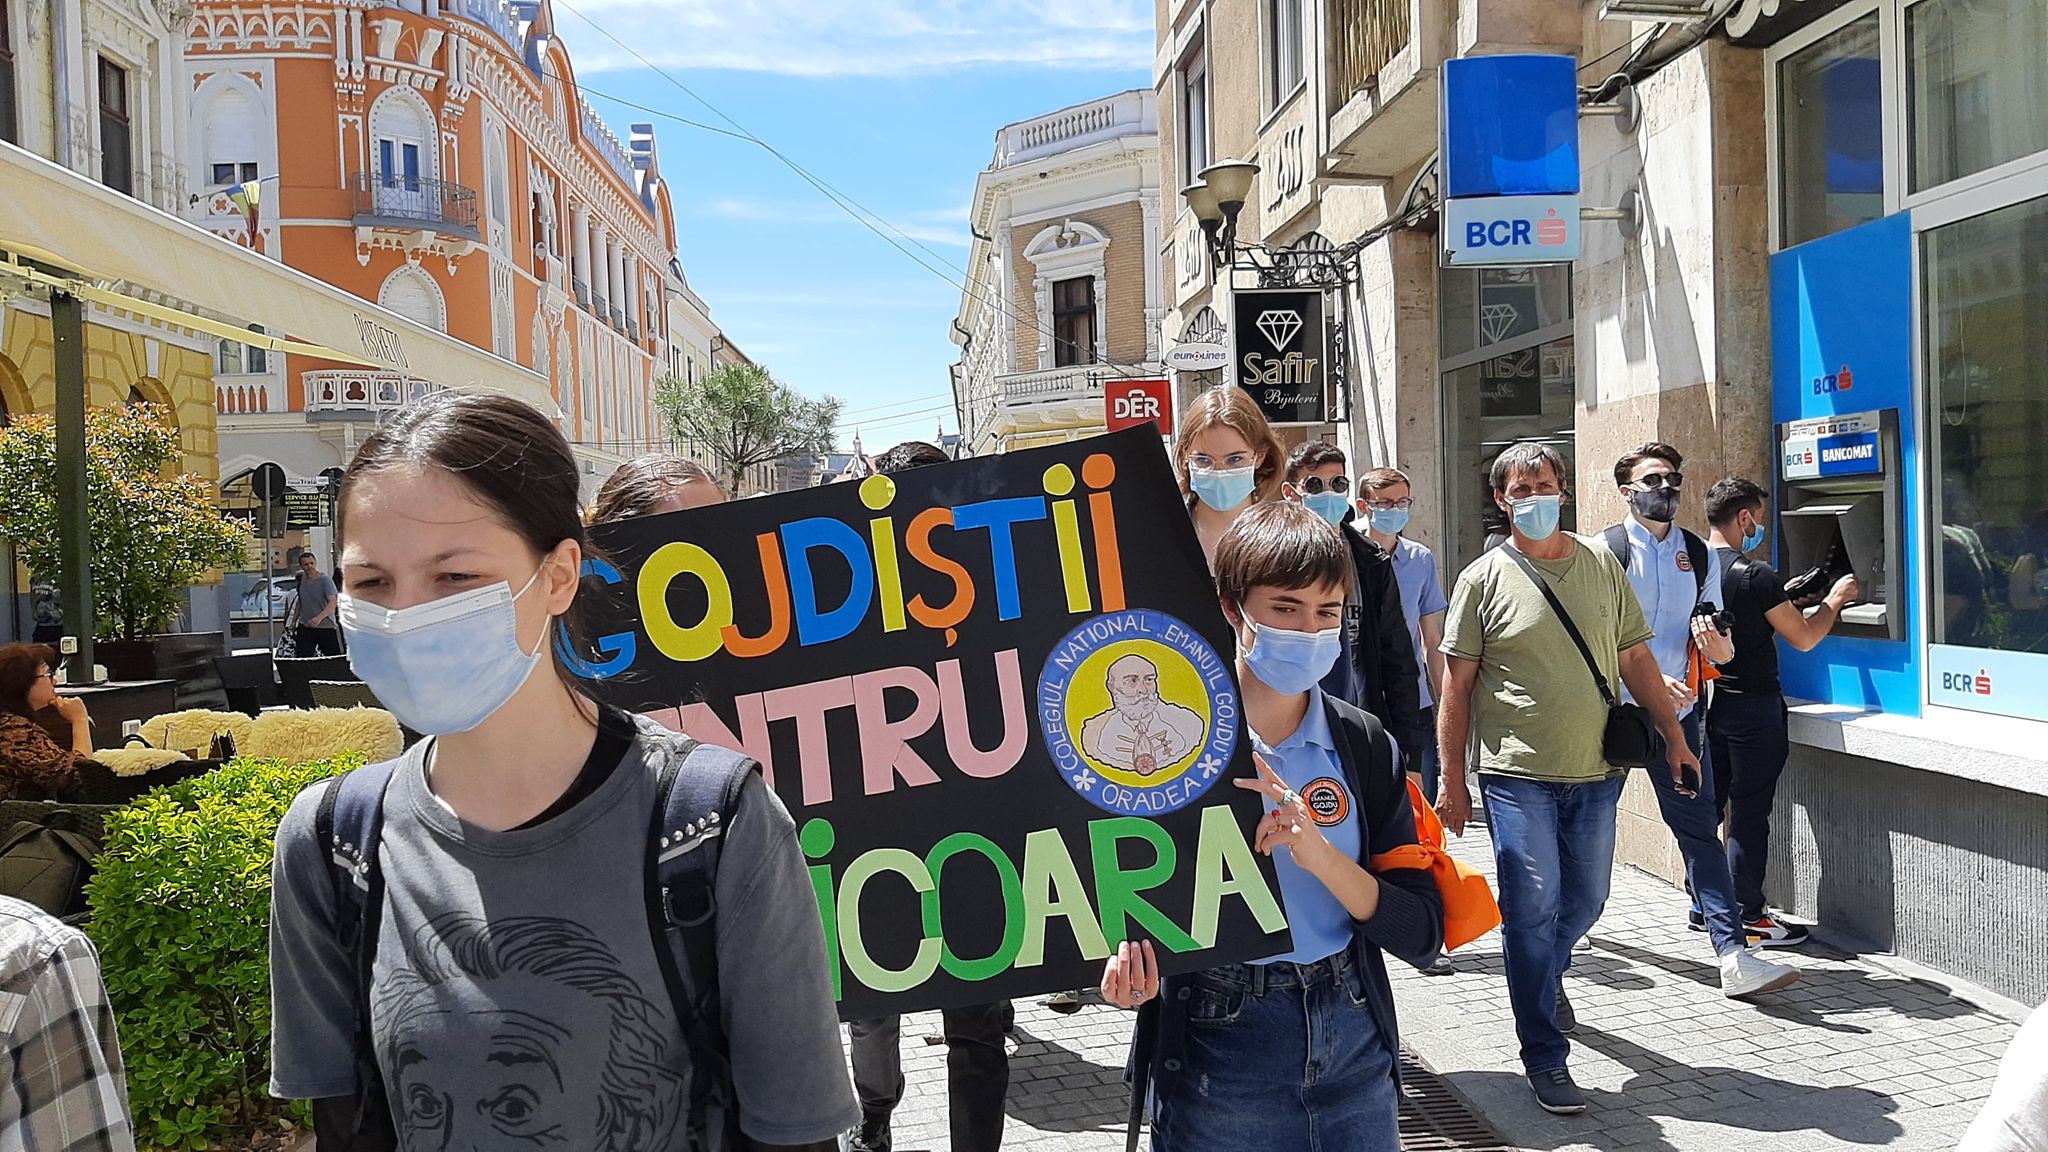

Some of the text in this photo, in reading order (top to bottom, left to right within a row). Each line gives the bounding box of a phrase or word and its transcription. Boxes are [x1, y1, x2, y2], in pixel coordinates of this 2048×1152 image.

[1466, 219, 1531, 248] BCR
[1243, 352, 1318, 385] Safir
[1264, 388, 1319, 410] Bijuterii
[1813, 374, 1837, 395] BCR
[1114, 397, 1161, 418] DER
[1786, 453, 1803, 466] BCR
[1822, 444, 1874, 463] BANCOMAT
[1943, 672, 1972, 693] BCR
[638, 647, 1028, 806] NTRU
[1044, 681, 1079, 771] COLEGIUL
[1102, 776, 1202, 811] ORADEA
[800, 804, 1288, 1001] iCOARA
